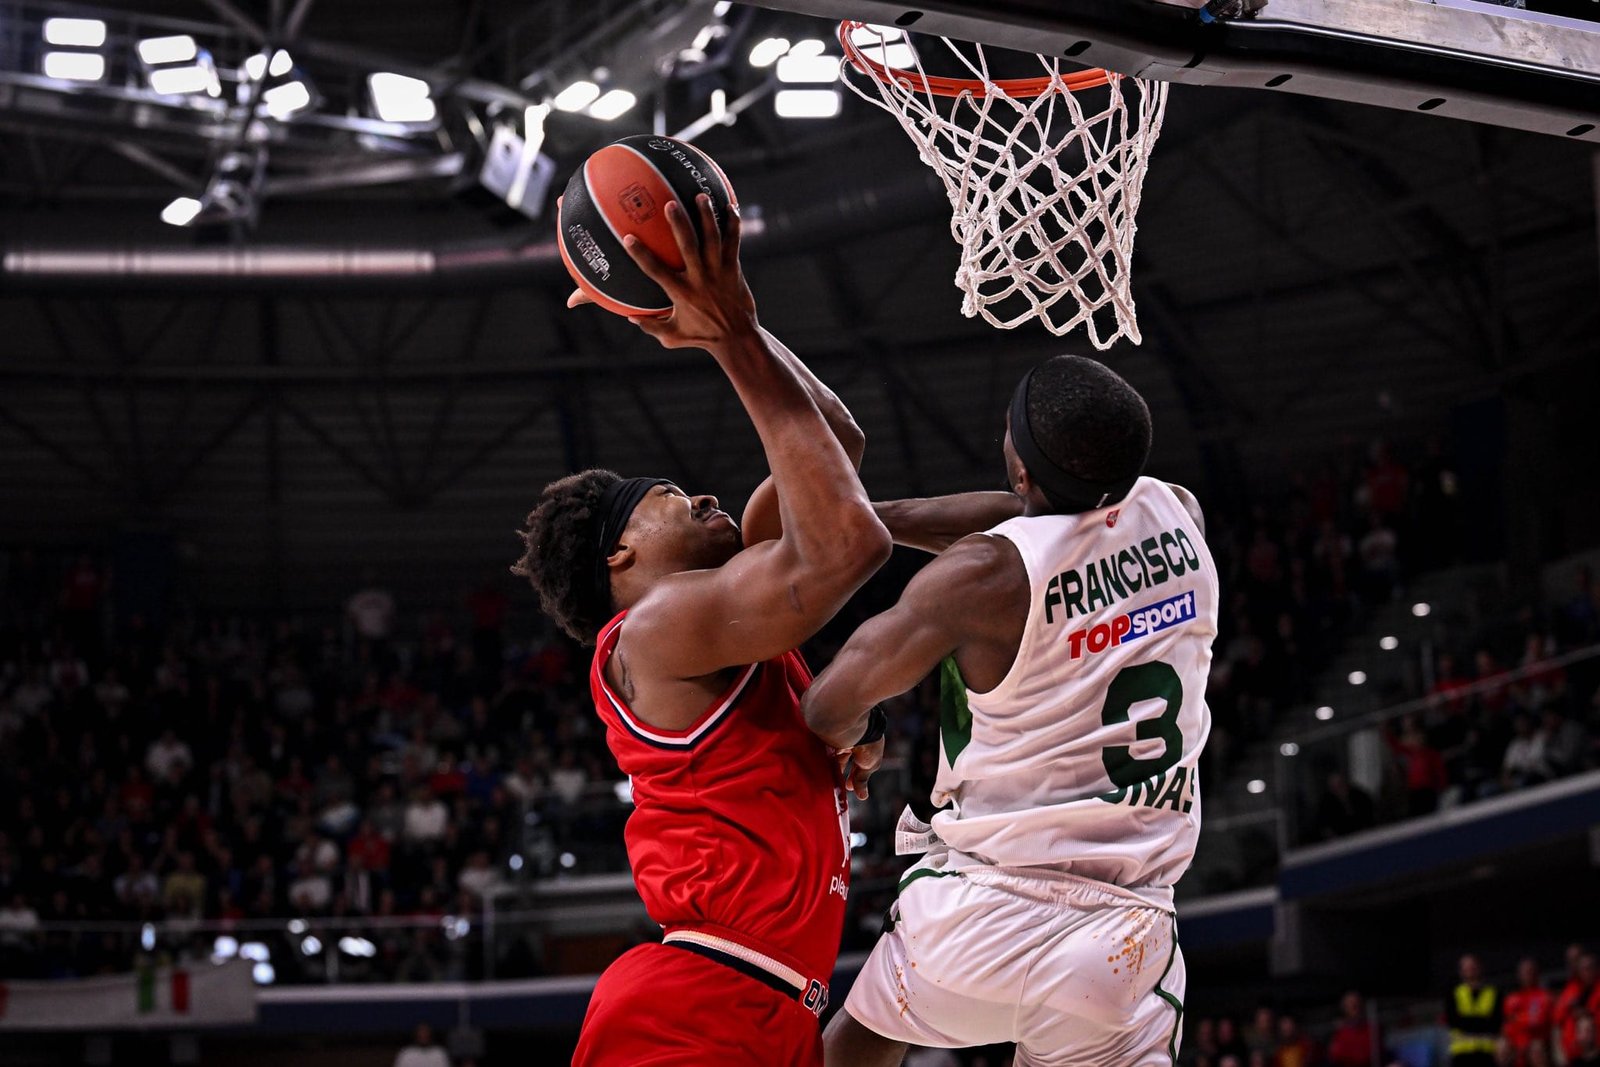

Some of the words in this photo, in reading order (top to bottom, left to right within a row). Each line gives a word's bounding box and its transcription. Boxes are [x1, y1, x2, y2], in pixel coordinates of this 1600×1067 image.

[669, 149, 719, 219] EuroLe
[1045, 528, 1199, 624] FRANCISCO
[1101, 660, 1183, 789] 3
